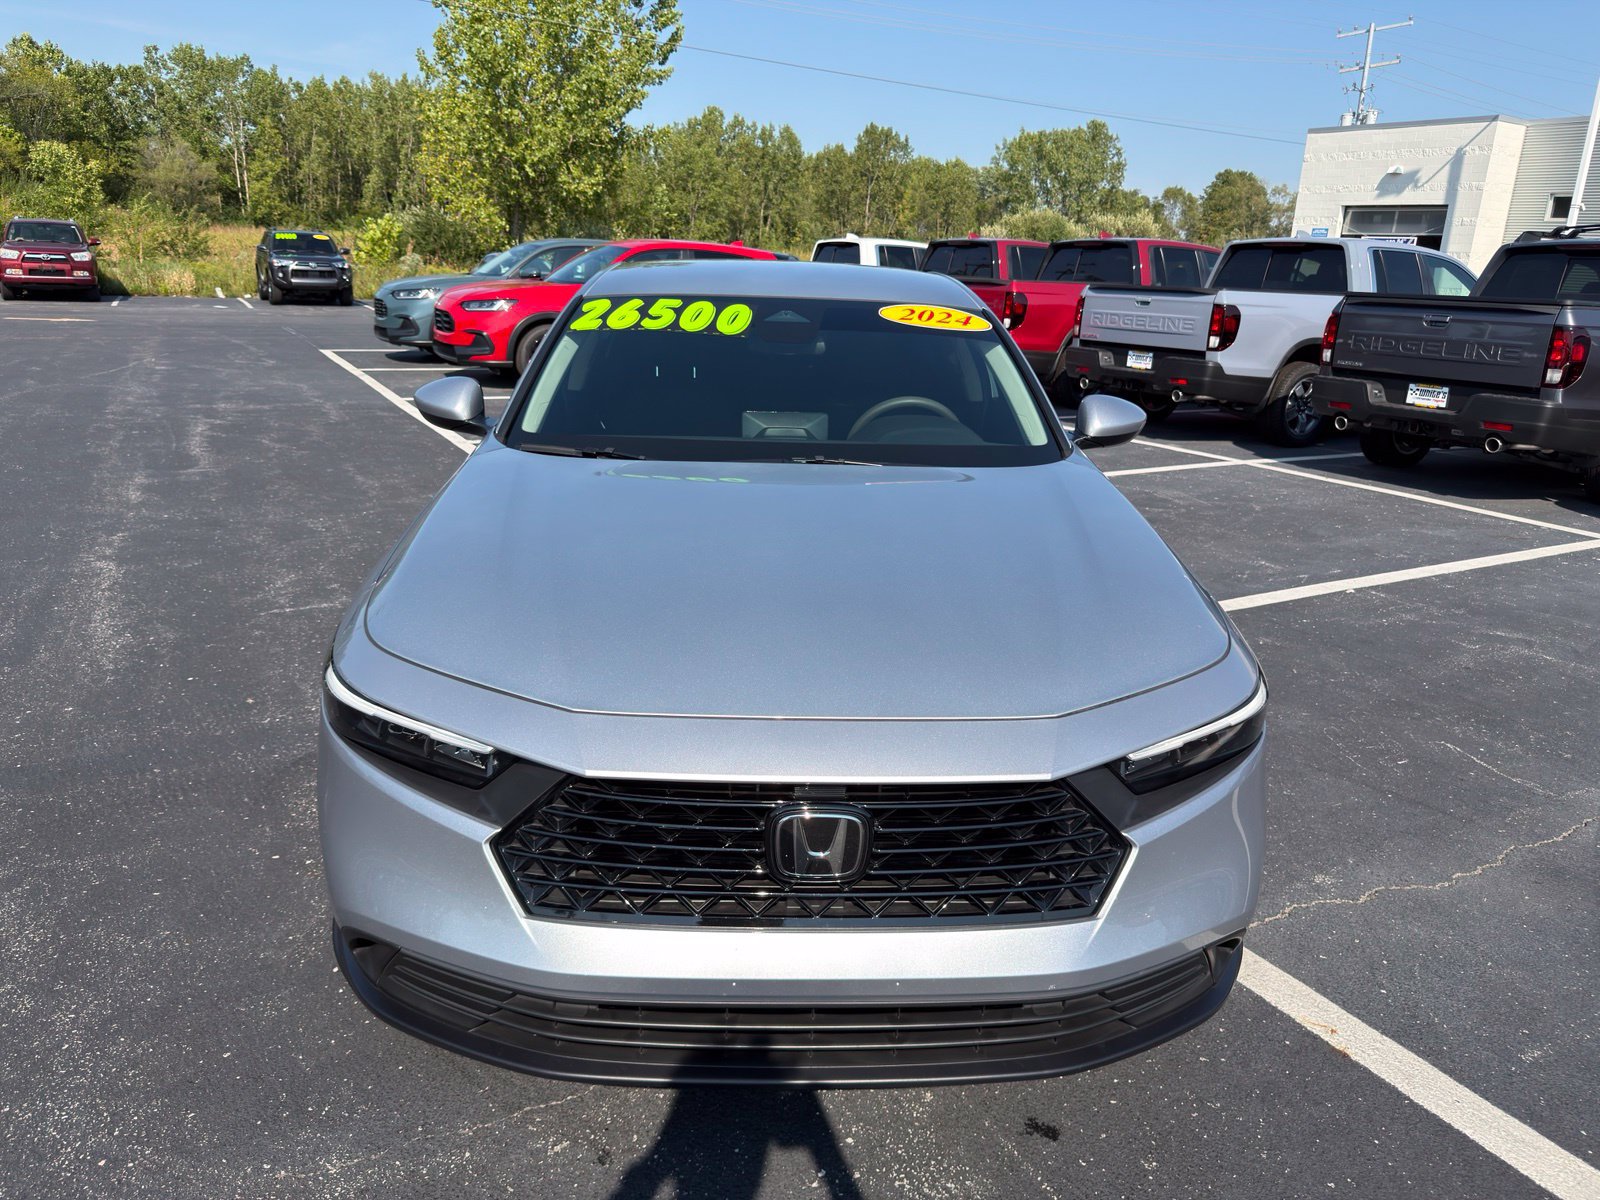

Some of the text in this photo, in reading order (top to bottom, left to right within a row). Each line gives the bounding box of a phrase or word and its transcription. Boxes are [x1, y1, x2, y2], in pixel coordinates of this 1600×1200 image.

[569, 299, 752, 335] 26500
[898, 308, 974, 327] 2024
[1090, 312, 1195, 333] RIDGELINE
[1350, 334, 1523, 364] RIDGELINE
